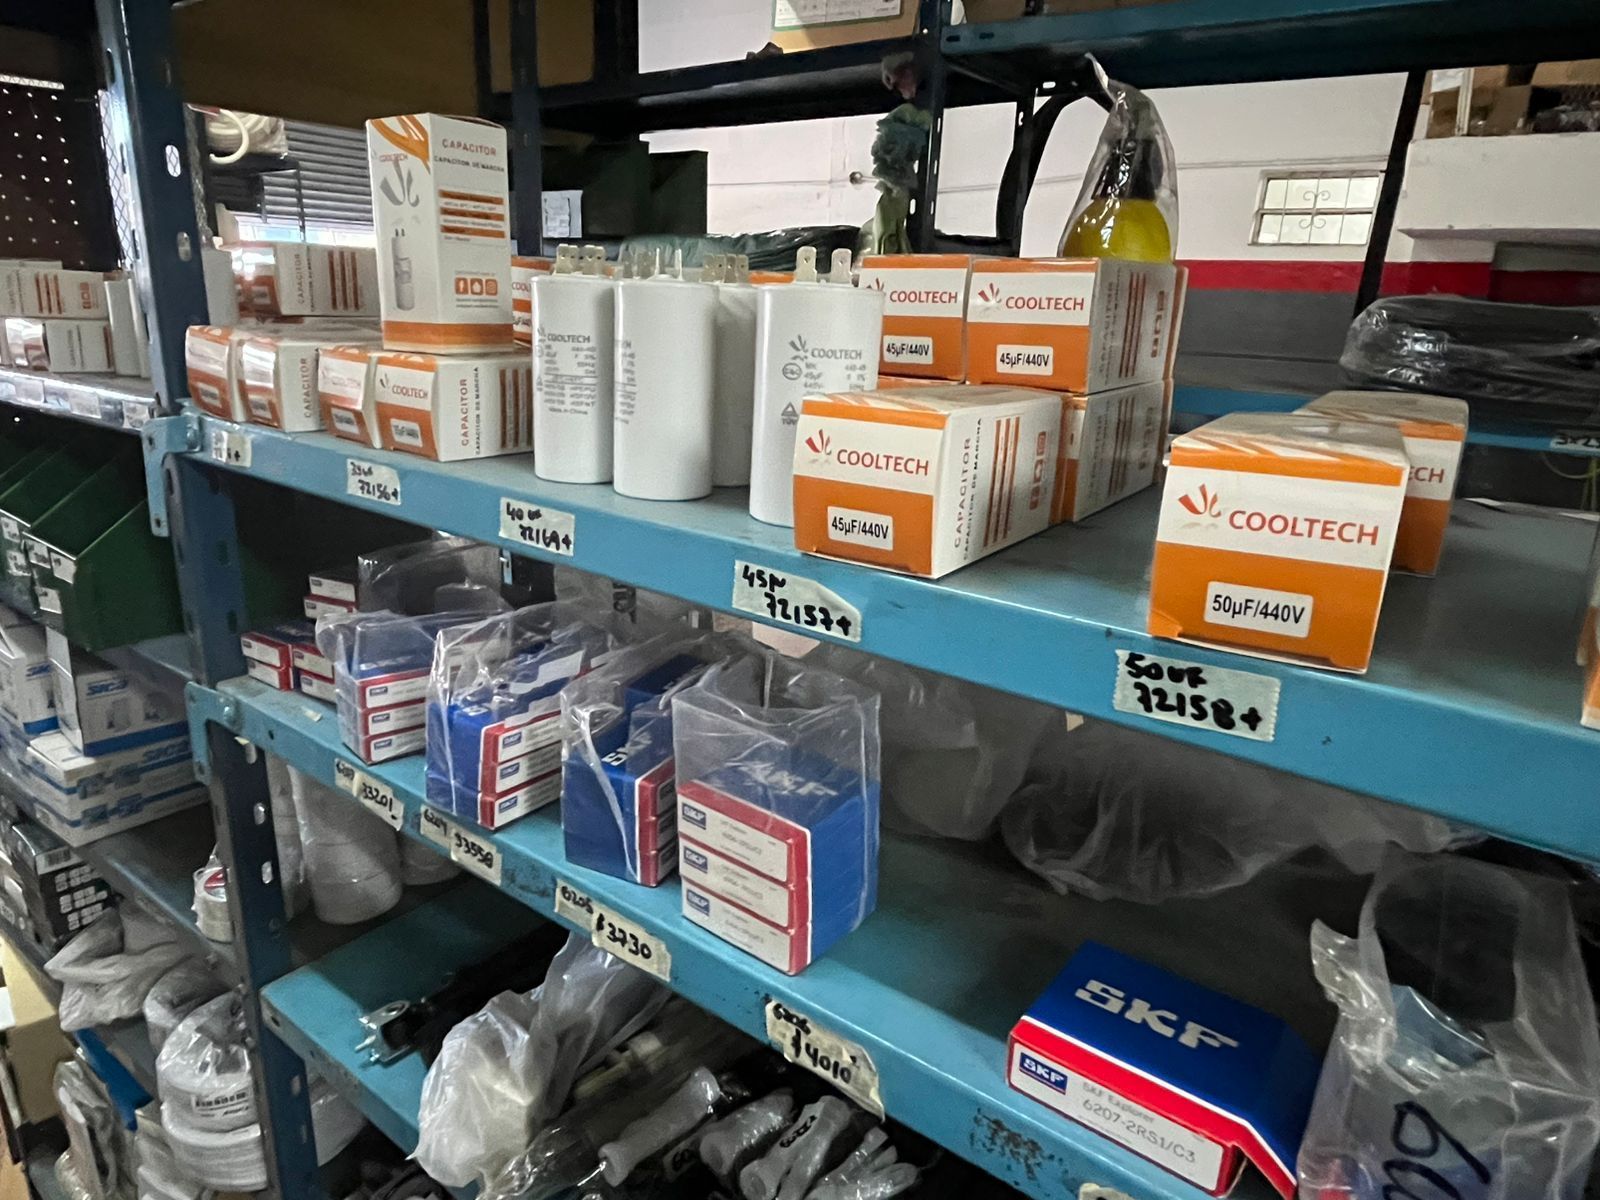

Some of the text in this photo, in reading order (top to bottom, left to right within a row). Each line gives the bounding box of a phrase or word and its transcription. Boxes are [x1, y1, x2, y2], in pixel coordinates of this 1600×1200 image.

[442, 138, 497, 156] CAPACITOR
[889, 290, 958, 304] COOLTECH
[1005, 296, 1085, 311] COOLTECH
[546, 333, 591, 344] COOLTECH
[811, 348, 862, 360] COOLTECH
[300, 358, 311, 418] CAPACITOR
[392, 384, 429, 400] COOLTECH
[459, 378, 470, 447] CAPACITOR
[836, 448, 930, 476] COOLTECH
[954, 438, 972, 548] CAPACITOR
[963, 494, 975, 561] CAPACITOR
[974, 418, 982, 471] MARCHA
[831, 518, 889, 540] 45µF/440V
[1228, 509, 1380, 546] COOLTECH
[1212, 594, 1306, 626] 50µF/440V
[561, 886, 594, 914] 6205
[1074, 979, 1240, 1049] SKF
[1022, 1058, 1065, 1084] SKF
[1082, 1082, 1156, 1124] SKF Explorer
[1082, 1099, 1197, 1164] 6207-2RS1/C3
